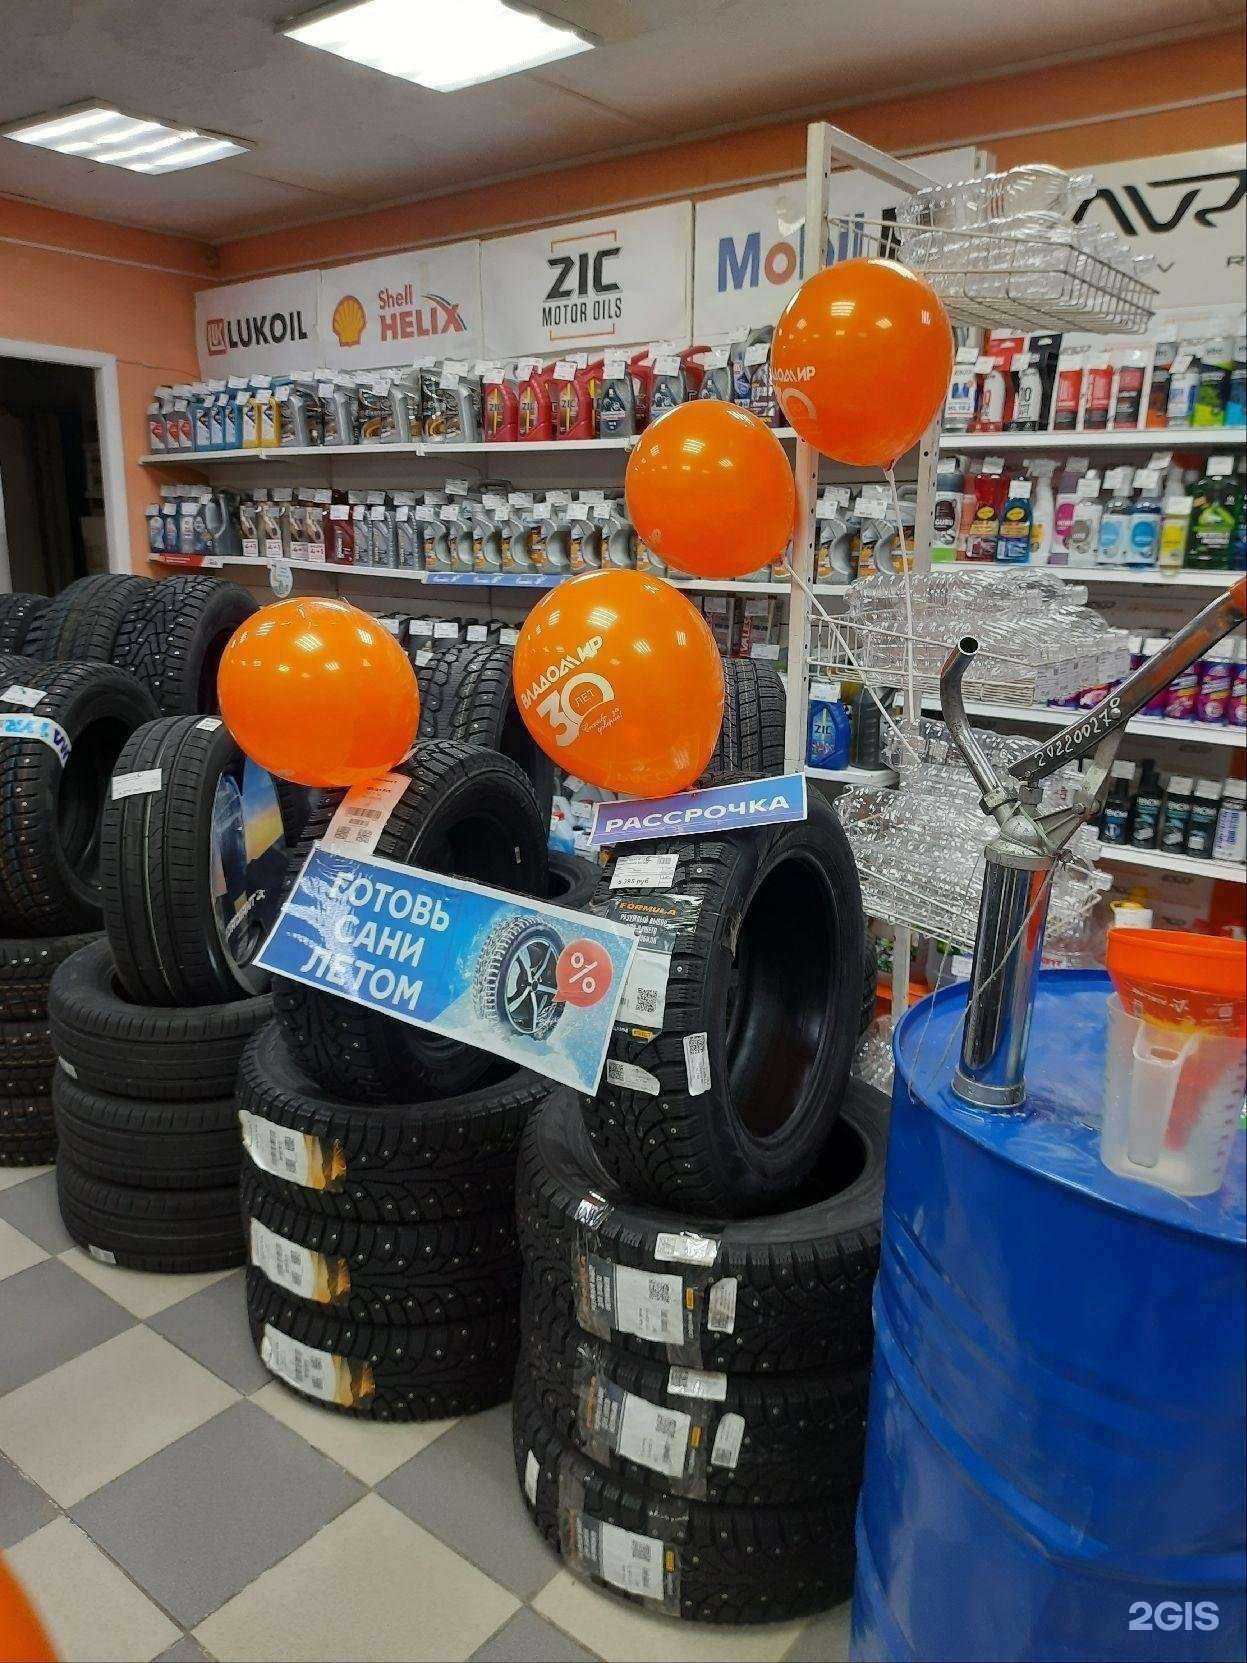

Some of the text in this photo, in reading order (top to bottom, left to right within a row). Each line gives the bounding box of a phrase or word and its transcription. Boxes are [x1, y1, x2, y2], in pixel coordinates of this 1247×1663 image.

[543, 246, 624, 302] ZIC
[378, 284, 413, 310] Shell
[542, 298, 623, 327] MOTOR OILS
[226, 310, 308, 349] LUKOIL
[379, 303, 466, 342] HELIX
[536, 672, 615, 747] 30
[813, 724, 832, 735] ZIC
[605, 795, 790, 833] РАССРОЧКА
[330, 872, 450, 932] ГОТОВЬ
[619, 902, 677, 916] FORMULA
[335, 914, 425, 968] САНИ
[300, 948, 424, 1012] ЛЕТОМ
